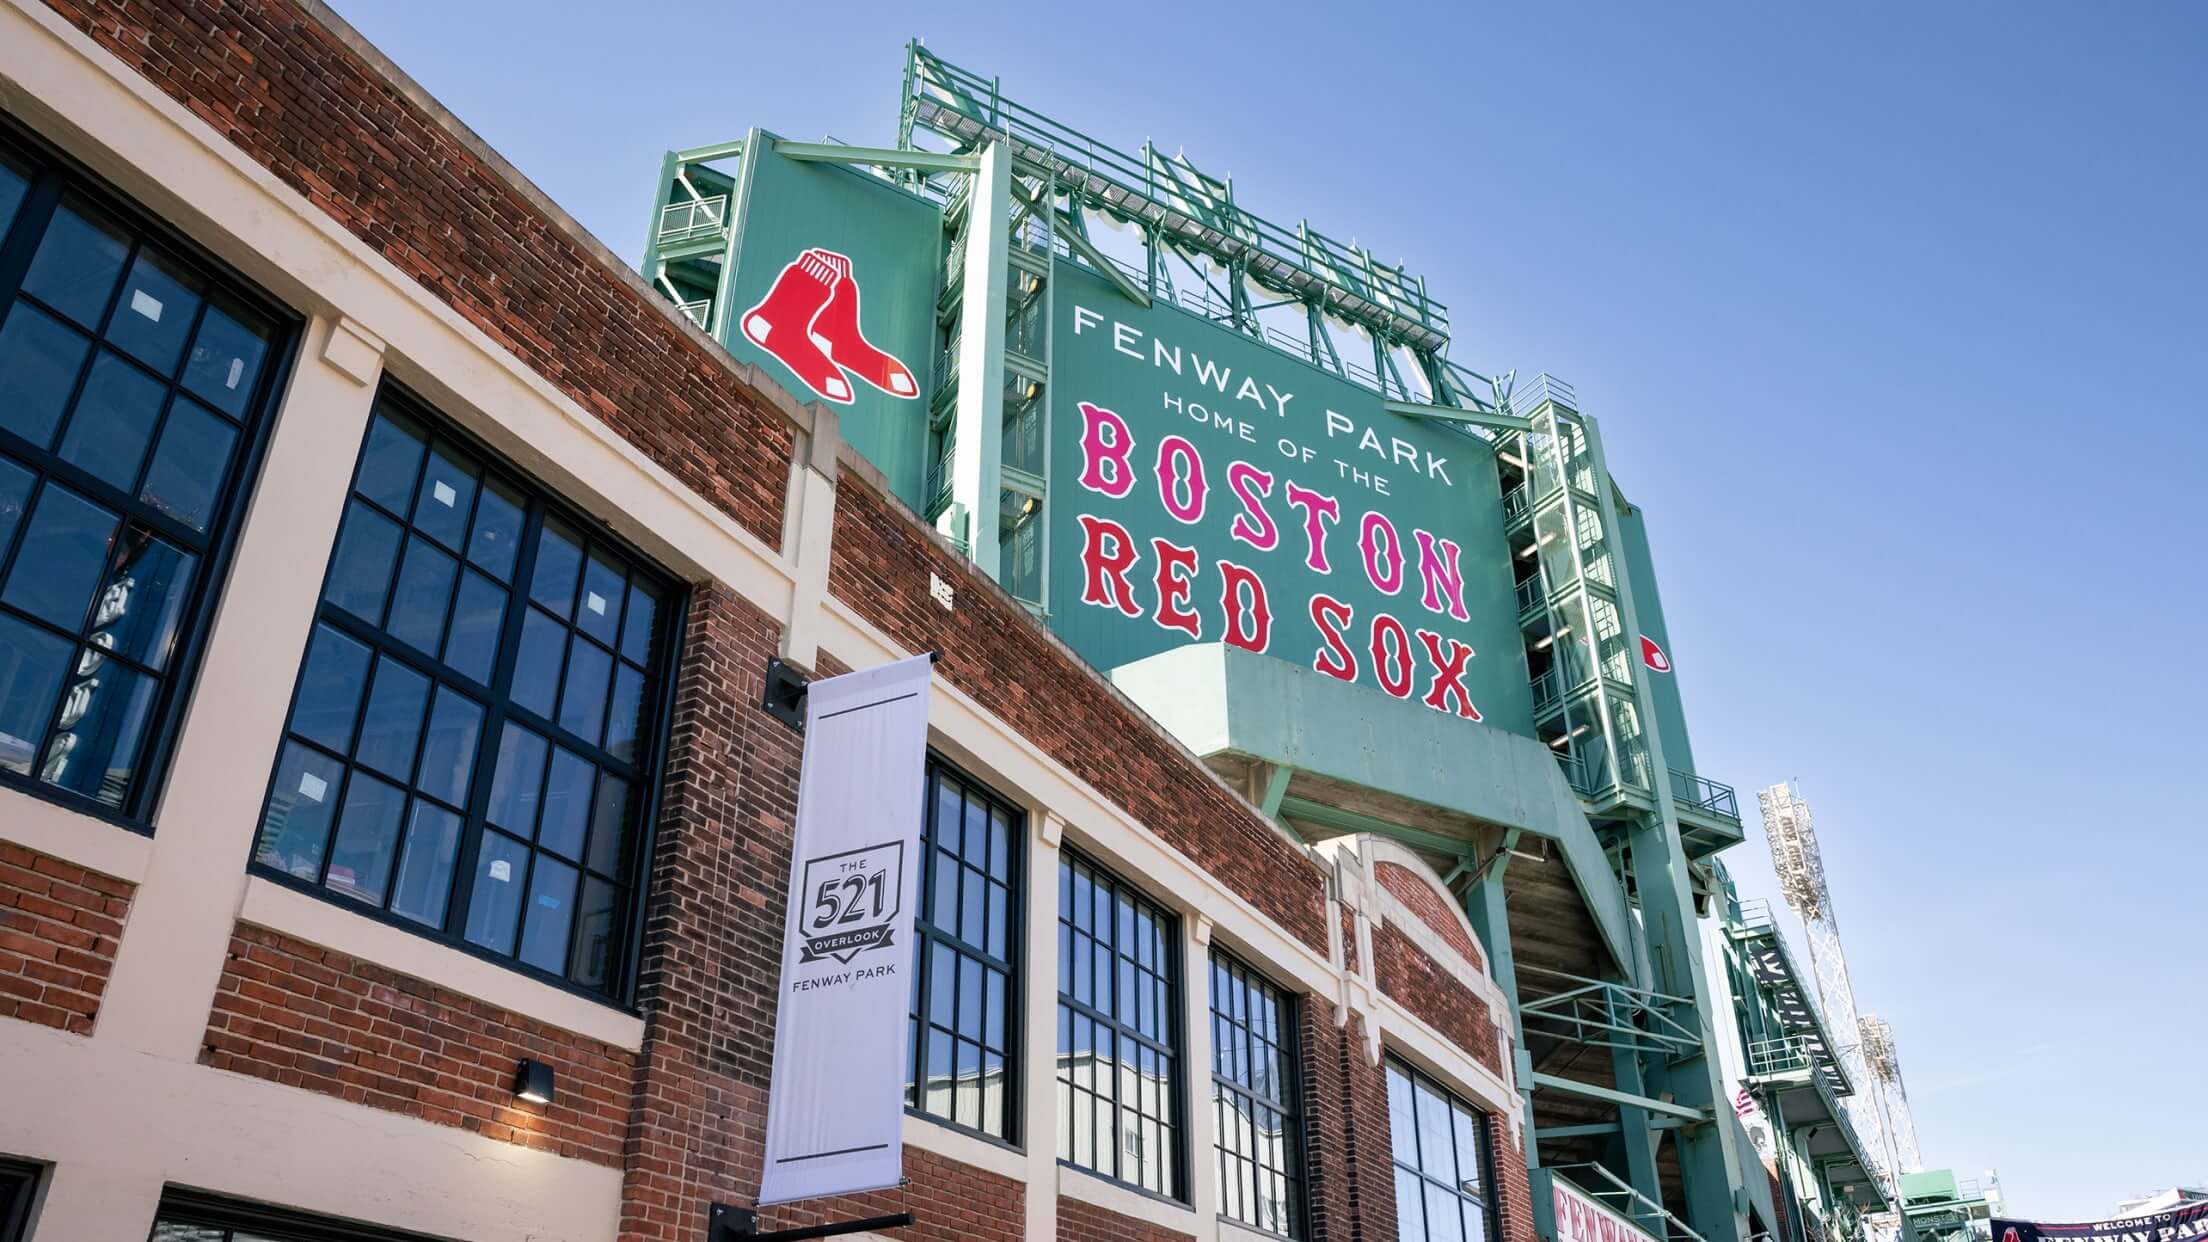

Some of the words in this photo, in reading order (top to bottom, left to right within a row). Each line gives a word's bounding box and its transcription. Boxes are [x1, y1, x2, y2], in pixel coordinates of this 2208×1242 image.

[1073, 305, 1295, 418] FENWAY
[1325, 409, 1453, 487] PARK
[1163, 391, 1257, 443] HOME
[1278, 438, 1317, 464] OF
[1334, 459, 1392, 496] THE
[1076, 401, 1471, 623] BOSTON
[1076, 514, 1274, 655] RED
[1308, 593, 1484, 723] SOX
[840, 859, 868, 873] THE
[813, 868, 887, 929] 521
[814, 929, 881, 951] OVERLOOK
[792, 972, 851, 993] FENWAY
[855, 963, 896, 981] PARK
[2092, 1217, 2153, 1232] WELCOME
[2155, 1213, 2171, 1223] TO
